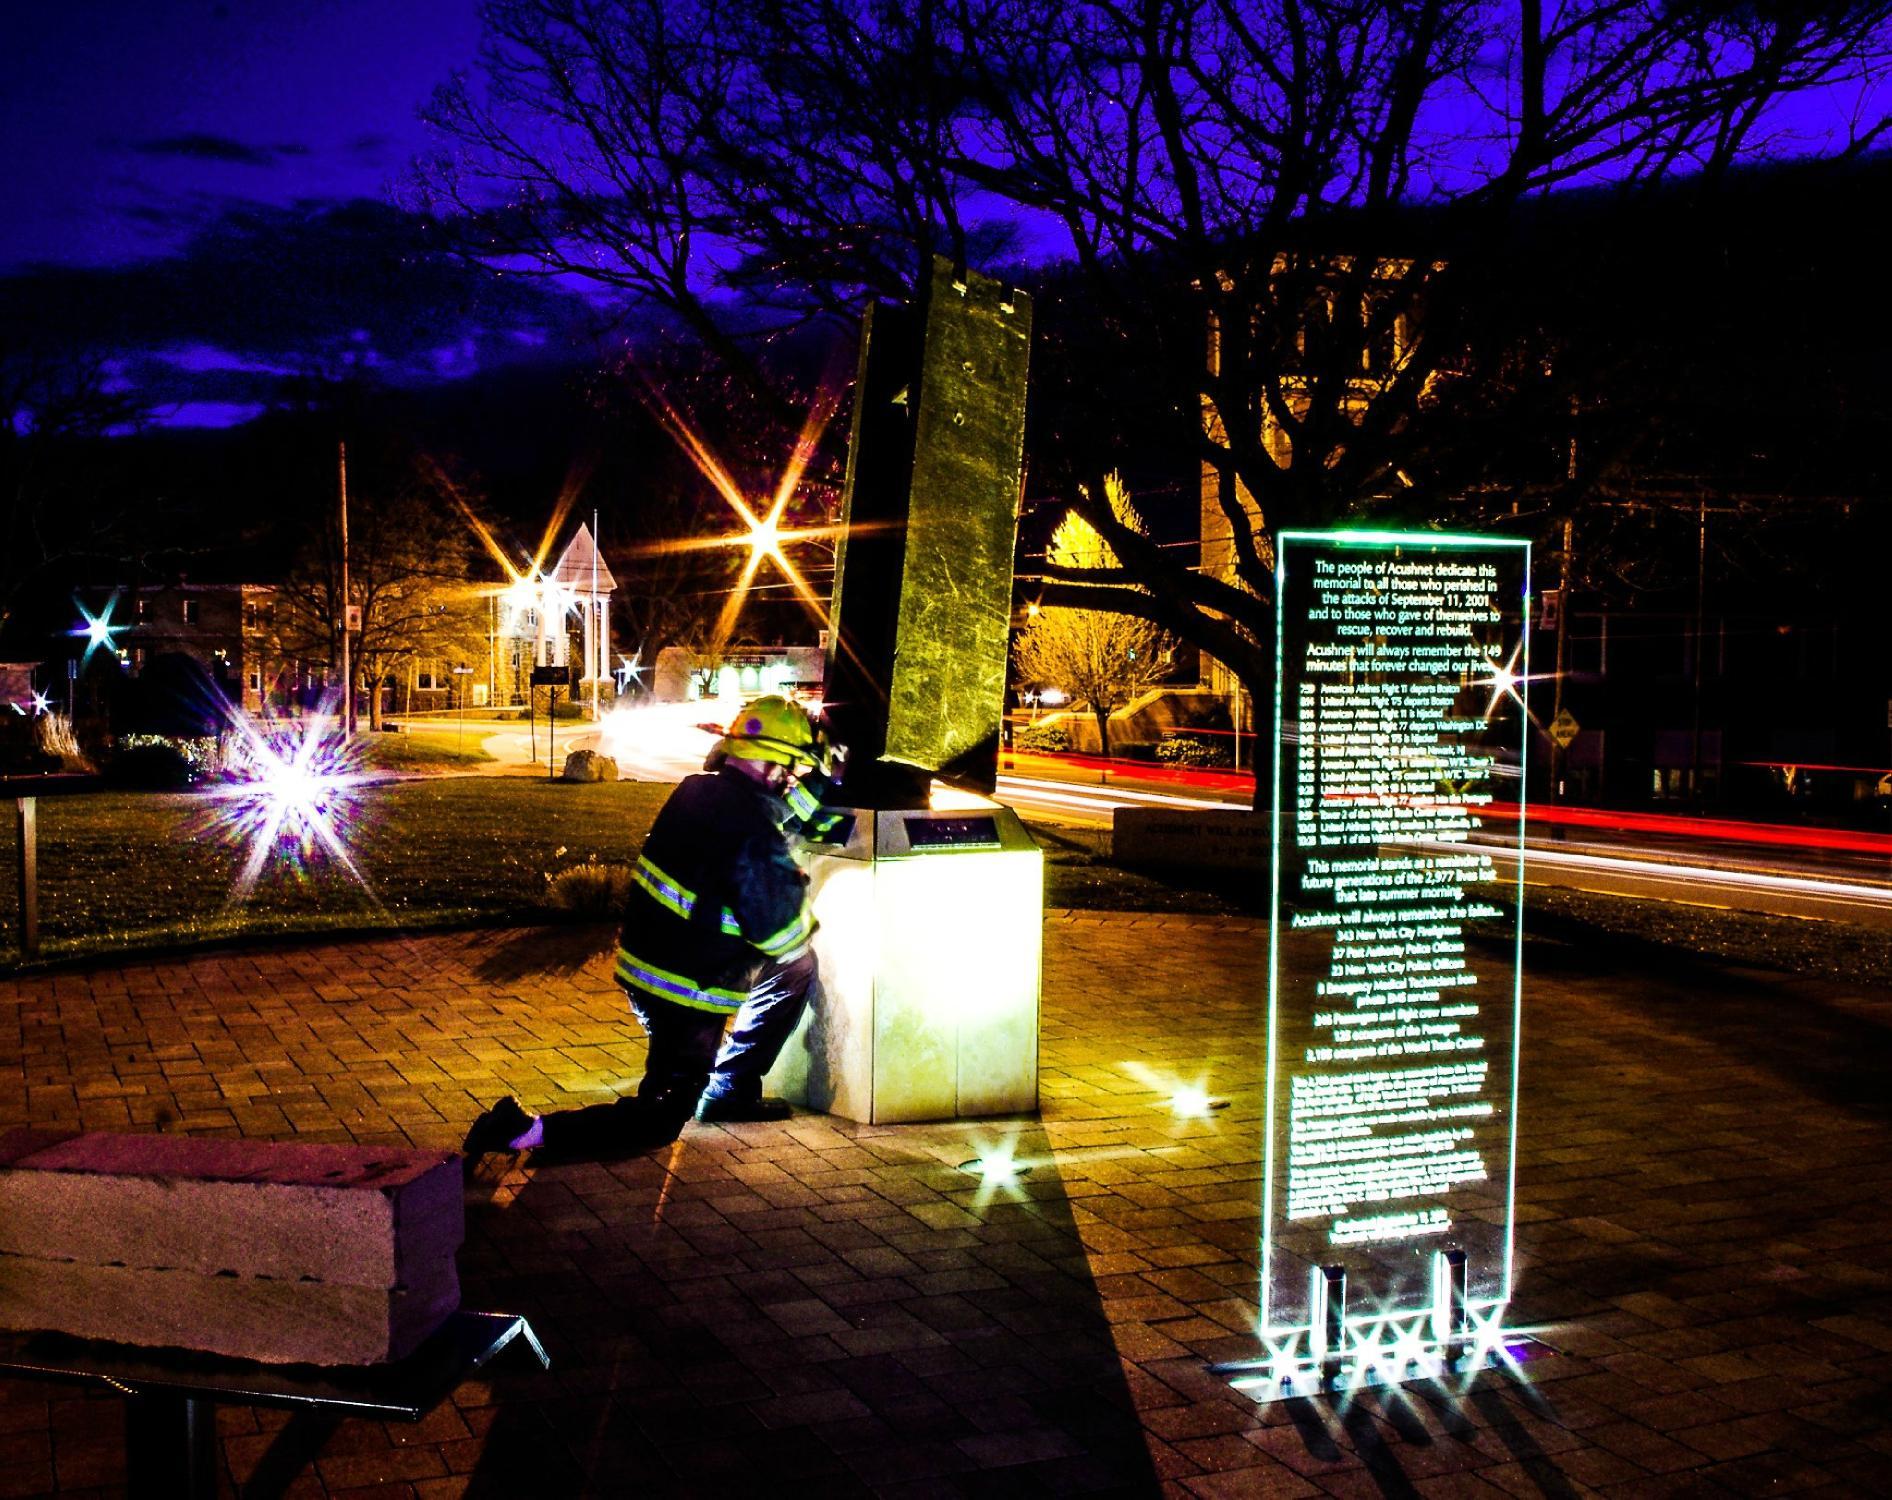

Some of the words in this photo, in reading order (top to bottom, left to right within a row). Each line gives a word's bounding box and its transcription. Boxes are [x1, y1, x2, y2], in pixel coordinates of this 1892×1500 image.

[1316, 562, 1335, 573] The
[1338, 563, 1373, 577] people
[1375, 563, 1386, 574] of
[1387, 564, 1434, 575] Acushnet
[1435, 565, 1477, 576] dedicate
[1479, 566, 1496, 577] this
[1314, 577, 1361, 589] memorial
[1364, 578, 1374, 589] to
[1377, 579, 1389, 590] all
[1391, 579, 1418, 590] those
[1420, 579, 1442, 591] who
[1444, 580, 1485, 594] perished
[1488, 581, 1497, 592] in
[1322, 593, 1340, 604] the
[1342, 593, 1376, 605] attacks
[1379, 594, 1389, 605] of
[1392, 594, 1444, 609] September
[1447, 595, 1463, 608] 11,
[1465, 596, 1489, 607] 2001
[1309, 608, 1328, 619] and
[1331, 608, 1342, 619] to
[1344, 609, 1372, 620] those
[1374, 609, 1396, 620] who
[1398, 611, 1421, 623] gave
[1423, 610, 1434, 621] of
[1436, 610, 1488, 621] themselves
[1490, 611, 1501, 622] to
[1338, 626, 1373, 637] rescue,
[1376, 626, 1413, 635] recover
[1415, 625, 1434, 636] and
[1436, 625, 1473, 636] rebuild.
[1307, 645, 1355, 656] Acushnet
[1356, 645, 1375, 656] will
[1376, 645, 1410, 659] always
[1412, 645, 1462, 656] remember
[1464, 645, 1481, 656] the
[1483, 646, 1502, 657] 149
[1306, 660, 1347, 671] minutes
[1349, 660, 1370, 671] that
[1371, 660, 1407, 671] forever
[1408, 660, 1449, 674] changed
[1452, 663, 1469, 671] our
[1308, 861, 1329, 873] This
[1331, 860, 1380, 872] memorial
[1381, 858, 1413, 870] stands
[1414, 860, 1425, 869] as
[1426, 859, 1434, 868] a
[1435, 855, 1480, 868] reminder
[1480, 855, 1492, 866] to
[1302, 877, 1334, 888] future
[1335, 874, 1393, 888] generations
[1394, 873, 1406, 885] of
[1407, 873, 1424, 884] the
[1425, 871, 1455, 885] 2,977
[1456, 870, 1478, 882] lives
[1479, 870, 1497, 881] lost
[1336, 891, 1357, 902] that
[1359, 890, 1378, 901] late
[1379, 890, 1419, 900] summer
[1421, 886, 1465, 899] morning.
[1292, 914, 1341, 926] Acushnet
[1342, 912, 1361, 924] will
[1362, 911, 1396, 924] always
[1398, 908, 1449, 921] remember
[1450, 907, 1467, 918] the
[1468, 905, 1504, 917] fallen...
